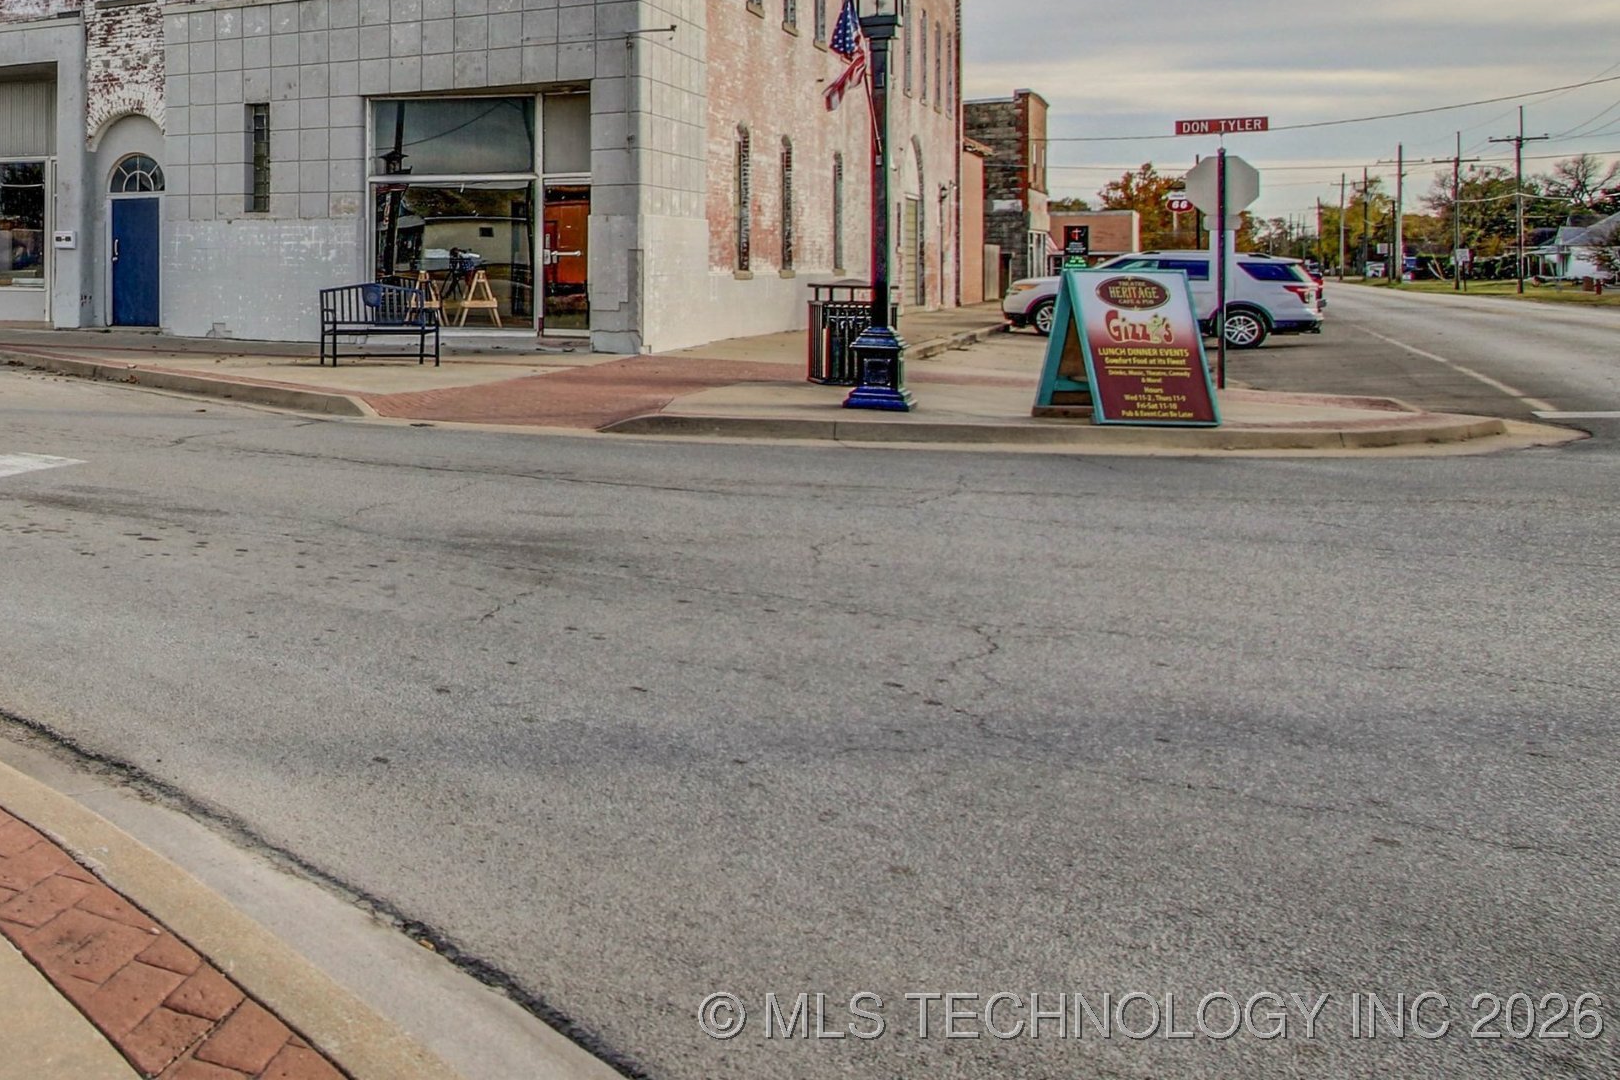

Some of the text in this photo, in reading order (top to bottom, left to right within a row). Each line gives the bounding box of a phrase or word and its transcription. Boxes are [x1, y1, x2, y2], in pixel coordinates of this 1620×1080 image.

[1182, 119, 1262, 133] DON TYLER
[1171, 200, 1188, 209] 66
[1108, 286, 1159, 299] HERITAGE
[1098, 347, 1189, 357] LUNCH DINNER EVENTS
